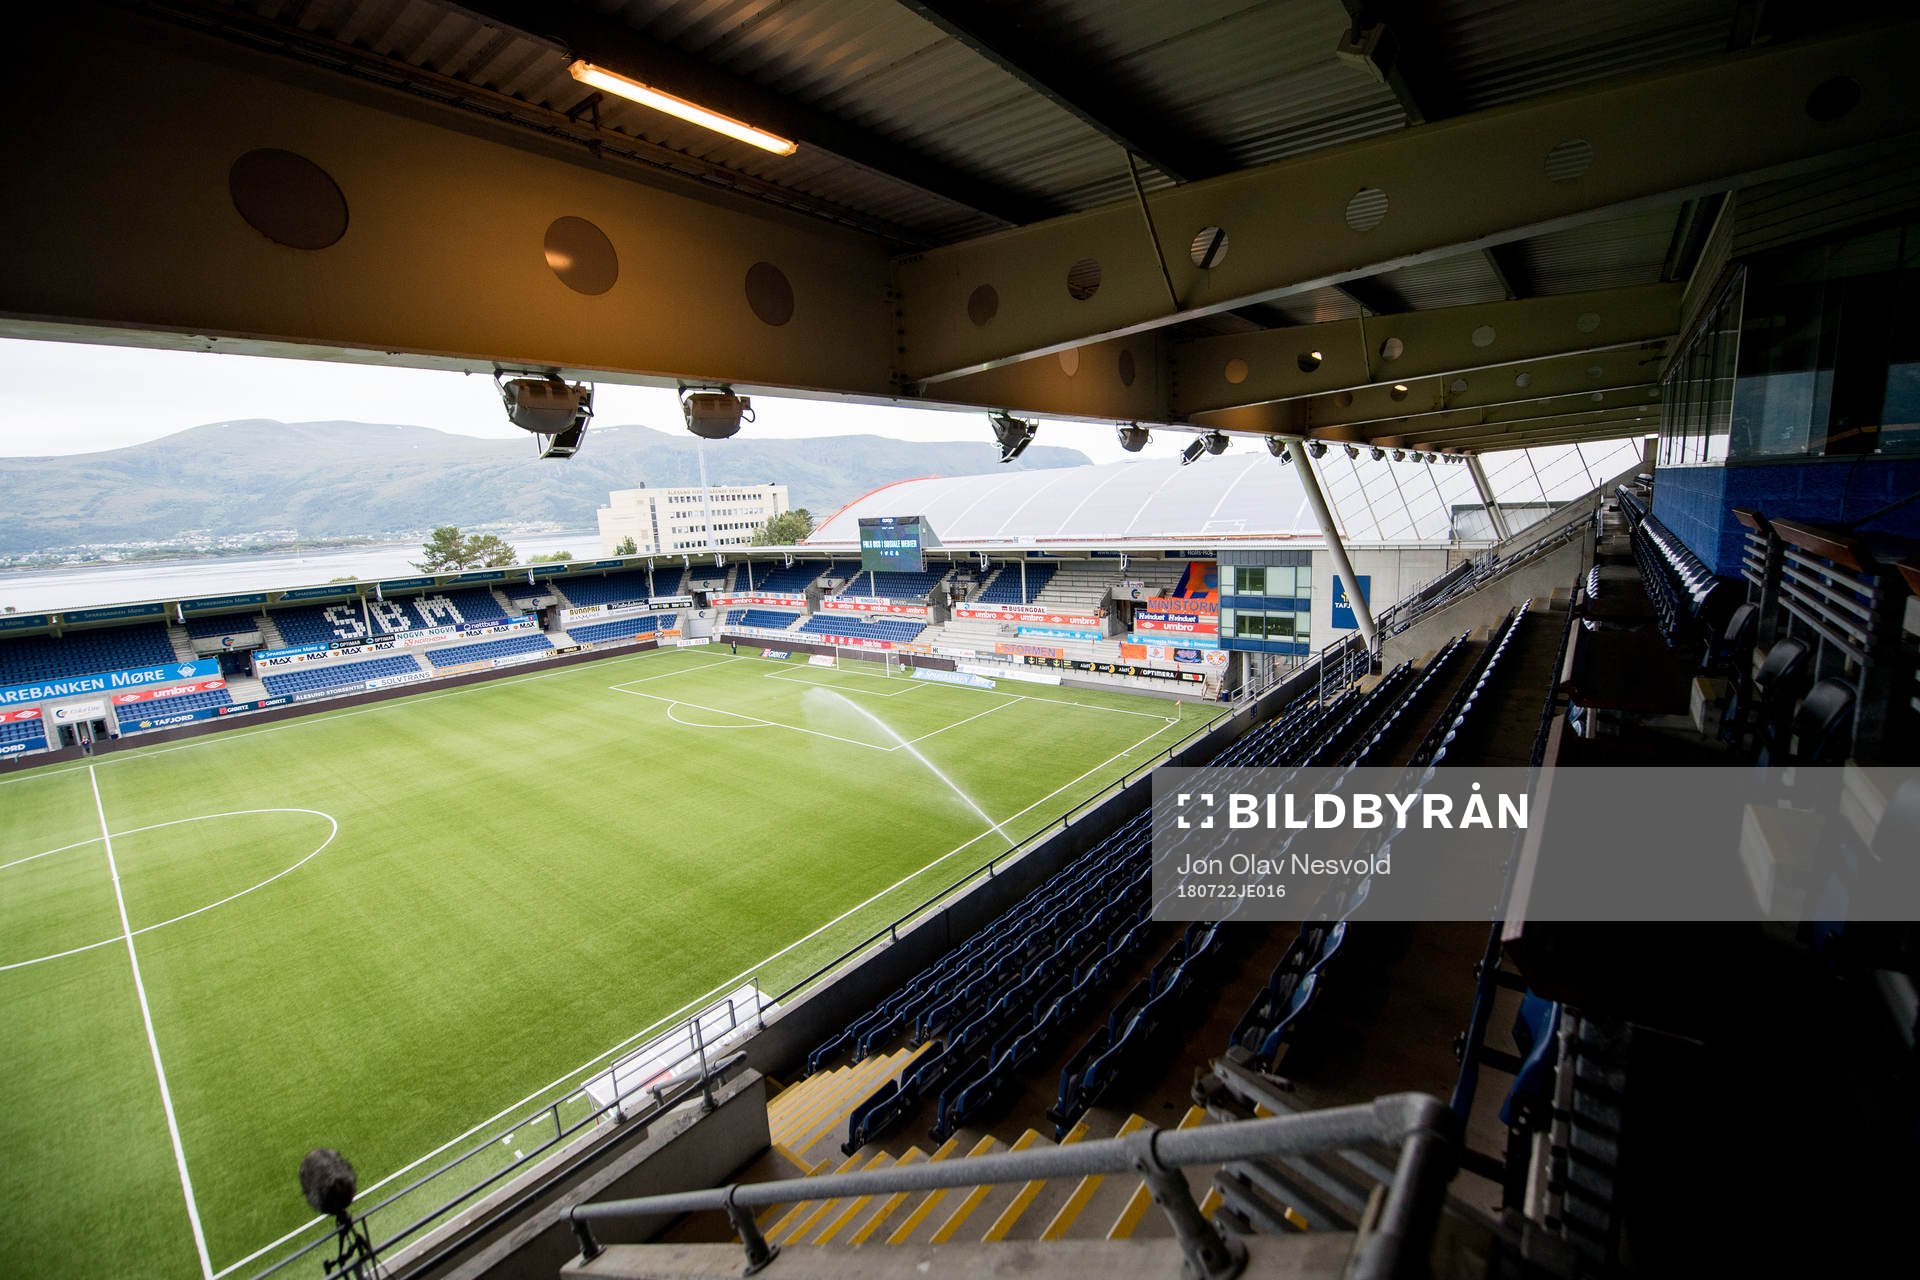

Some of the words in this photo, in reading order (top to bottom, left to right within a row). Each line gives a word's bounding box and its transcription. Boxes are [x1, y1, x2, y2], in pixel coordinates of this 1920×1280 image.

[975, 610, 997, 619] umbro
[1020, 613, 1044, 622] umbro
[1069, 616, 1096, 625] umbro
[1163, 623, 1194, 632] umbro
[341, 646, 362, 656] MAX
[375, 641, 395, 651] MAX
[1004, 644, 1056, 657] STORMEN
[269, 656, 291, 666] MAX
[306, 651, 328, 661] MAX
[381, 671, 431, 686] SOLVTRANS
[153, 685, 196, 698] umbro
[153, 714, 194, 726] TAFJORD
